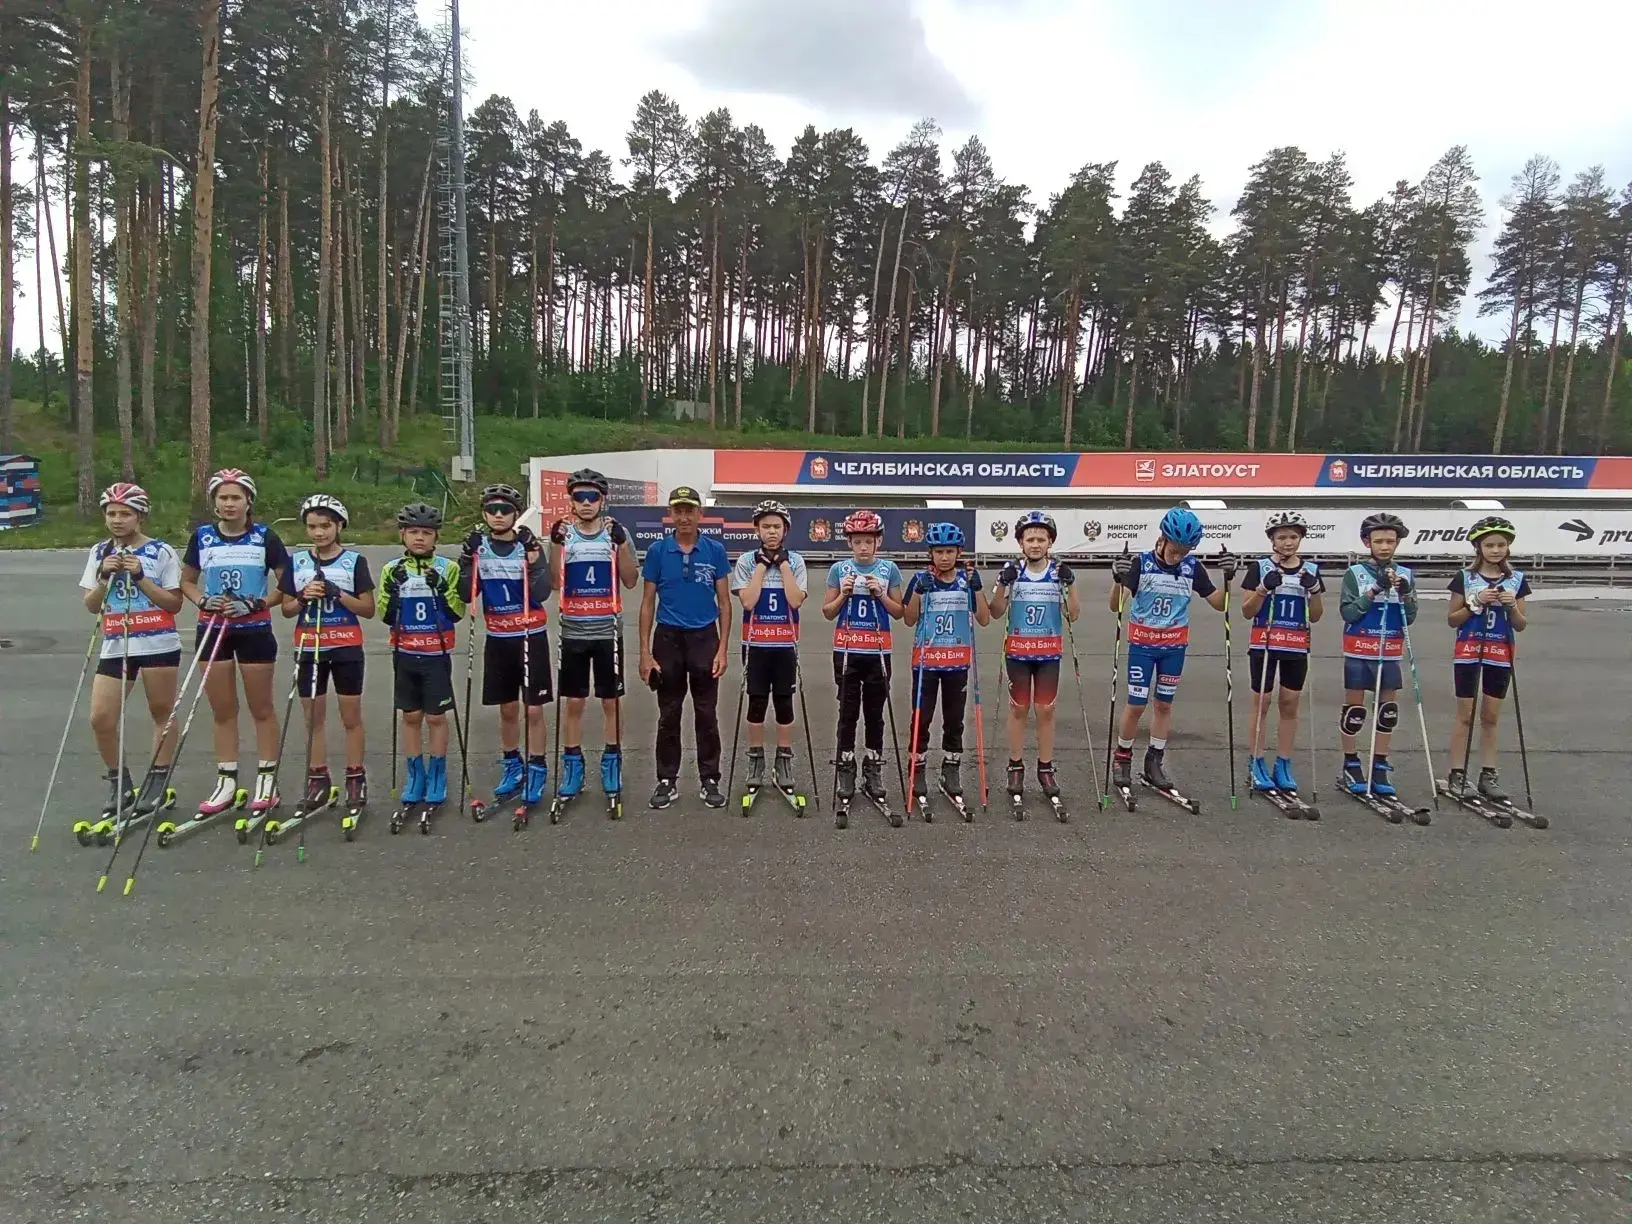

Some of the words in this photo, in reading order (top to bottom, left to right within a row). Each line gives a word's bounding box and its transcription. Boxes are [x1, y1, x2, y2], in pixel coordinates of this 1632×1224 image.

[834, 462, 974, 477] ЧЕЛЯБИНСКАЯ
[978, 463, 1066, 478] ОБЛАСТЬ
[1161, 463, 1261, 478] ЗЛАТОУСТ
[1353, 465, 1494, 479] ЧЕЛЯБИНСКАЯ
[1497, 465, 1584, 479] ОБЛАСТЬ
[636, 532, 664, 541] ФОНД
[665, 527, 722, 535] ПОЖКИ
[723, 532, 760, 541] СПОРТА
[1107, 532, 1138, 540] РОССИИ
[1414, 526, 1470, 545] prot
[220, 569, 242, 591] 33
[585, 565, 597, 585] 4
[502, 583, 511, 602] 1
[568, 600, 594, 611] Альфа
[769, 593, 778, 612] 5
[858, 599, 868, 618] 6
[1151, 597, 1173, 618] 35
[1279, 598, 1296, 619] 11
[415, 601, 427, 621] 8
[1025, 604, 1047, 626] 37
[136, 615, 163, 624] Банк
[935, 614, 955, 636] 34
[1486, 610, 1497, 630] 9
[837, 632, 863, 644] Альфа
[1133, 628, 1161, 639] Альфа
[1260, 631, 1286, 642] Аьфа
[1010, 639, 1036, 651] Альфа
[1037, 640, 1057, 649] Банк
[1354, 640, 1381, 652] Альф
[925, 650, 947, 661] льфа
